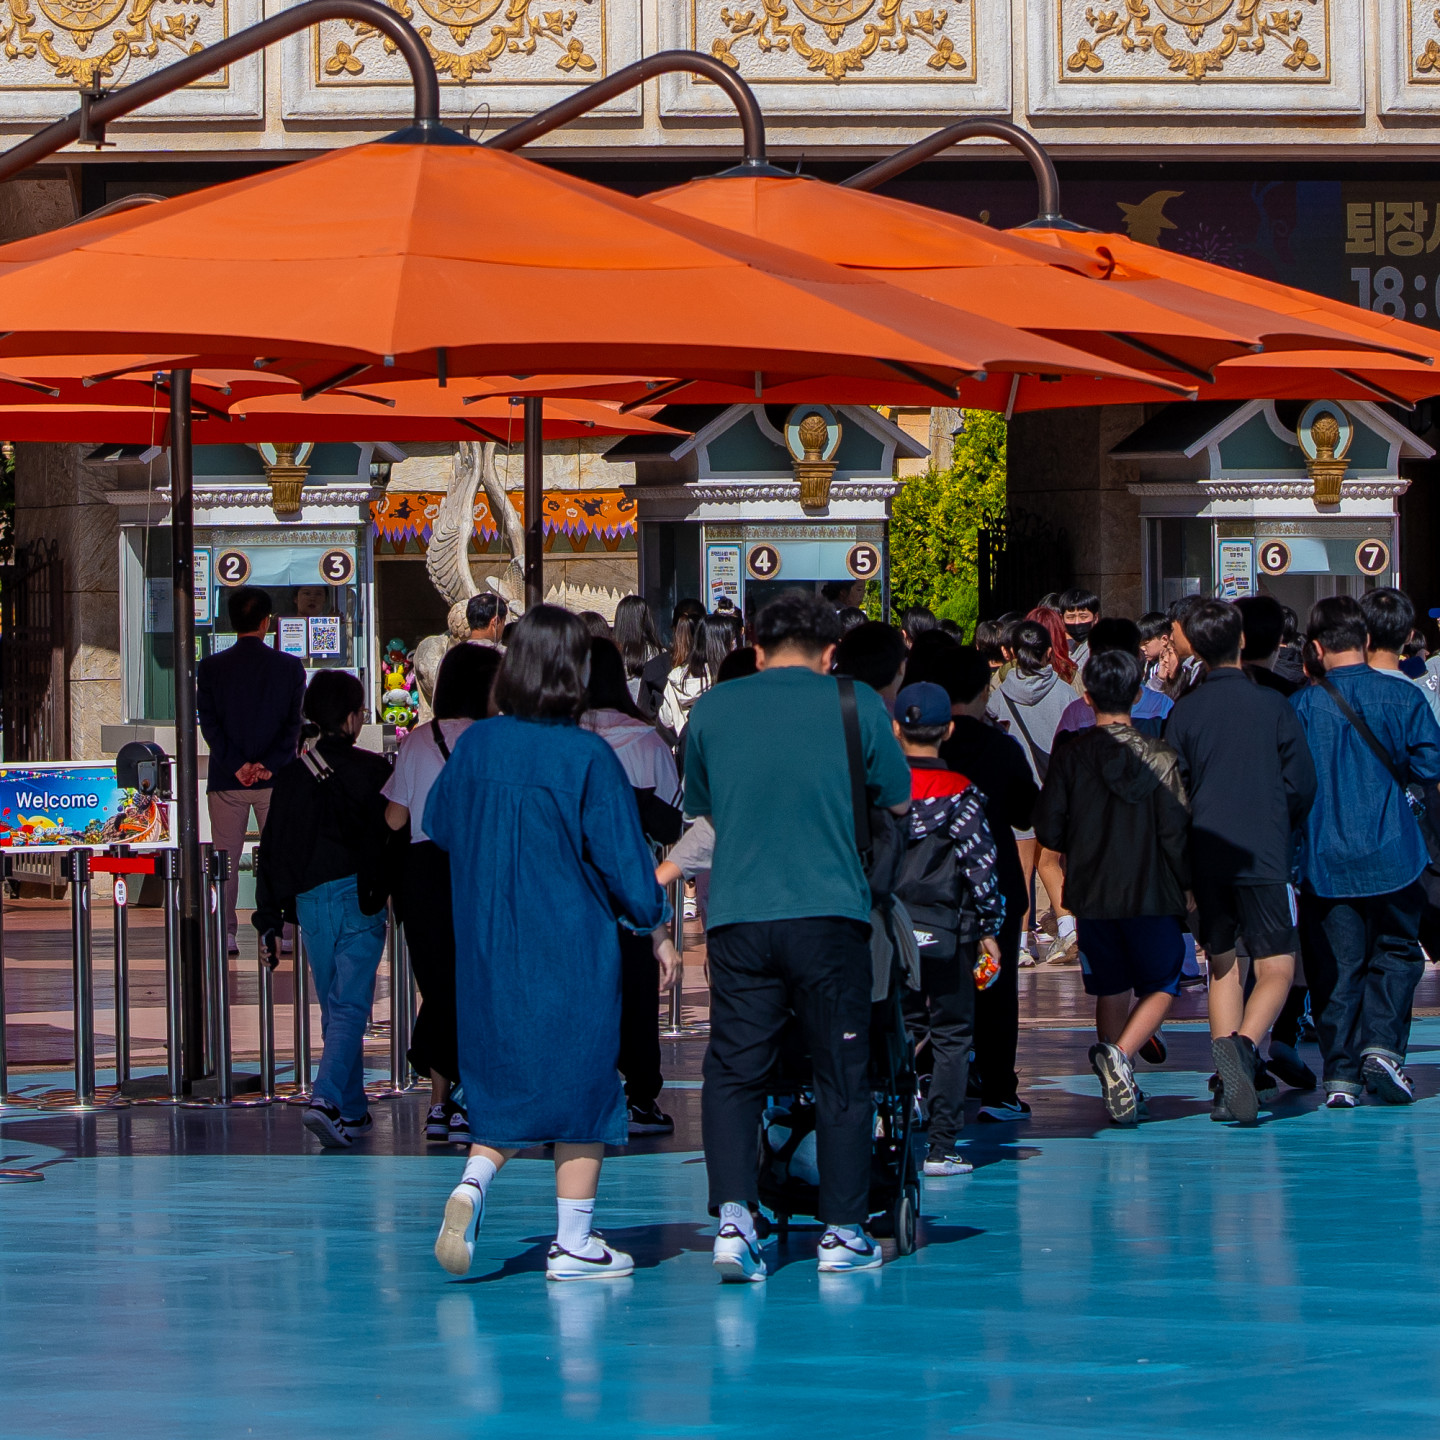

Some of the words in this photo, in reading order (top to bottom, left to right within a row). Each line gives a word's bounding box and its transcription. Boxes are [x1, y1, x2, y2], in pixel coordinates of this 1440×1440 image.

[226, 556, 241, 579] 2
[329, 555, 345, 578] 3
[754, 549, 771, 572] 4
[856, 549, 871, 572] 5
[1266, 546, 1281, 568] 6
[1364, 546, 1380, 568] 7
[15, 791, 99, 809] Welcome
